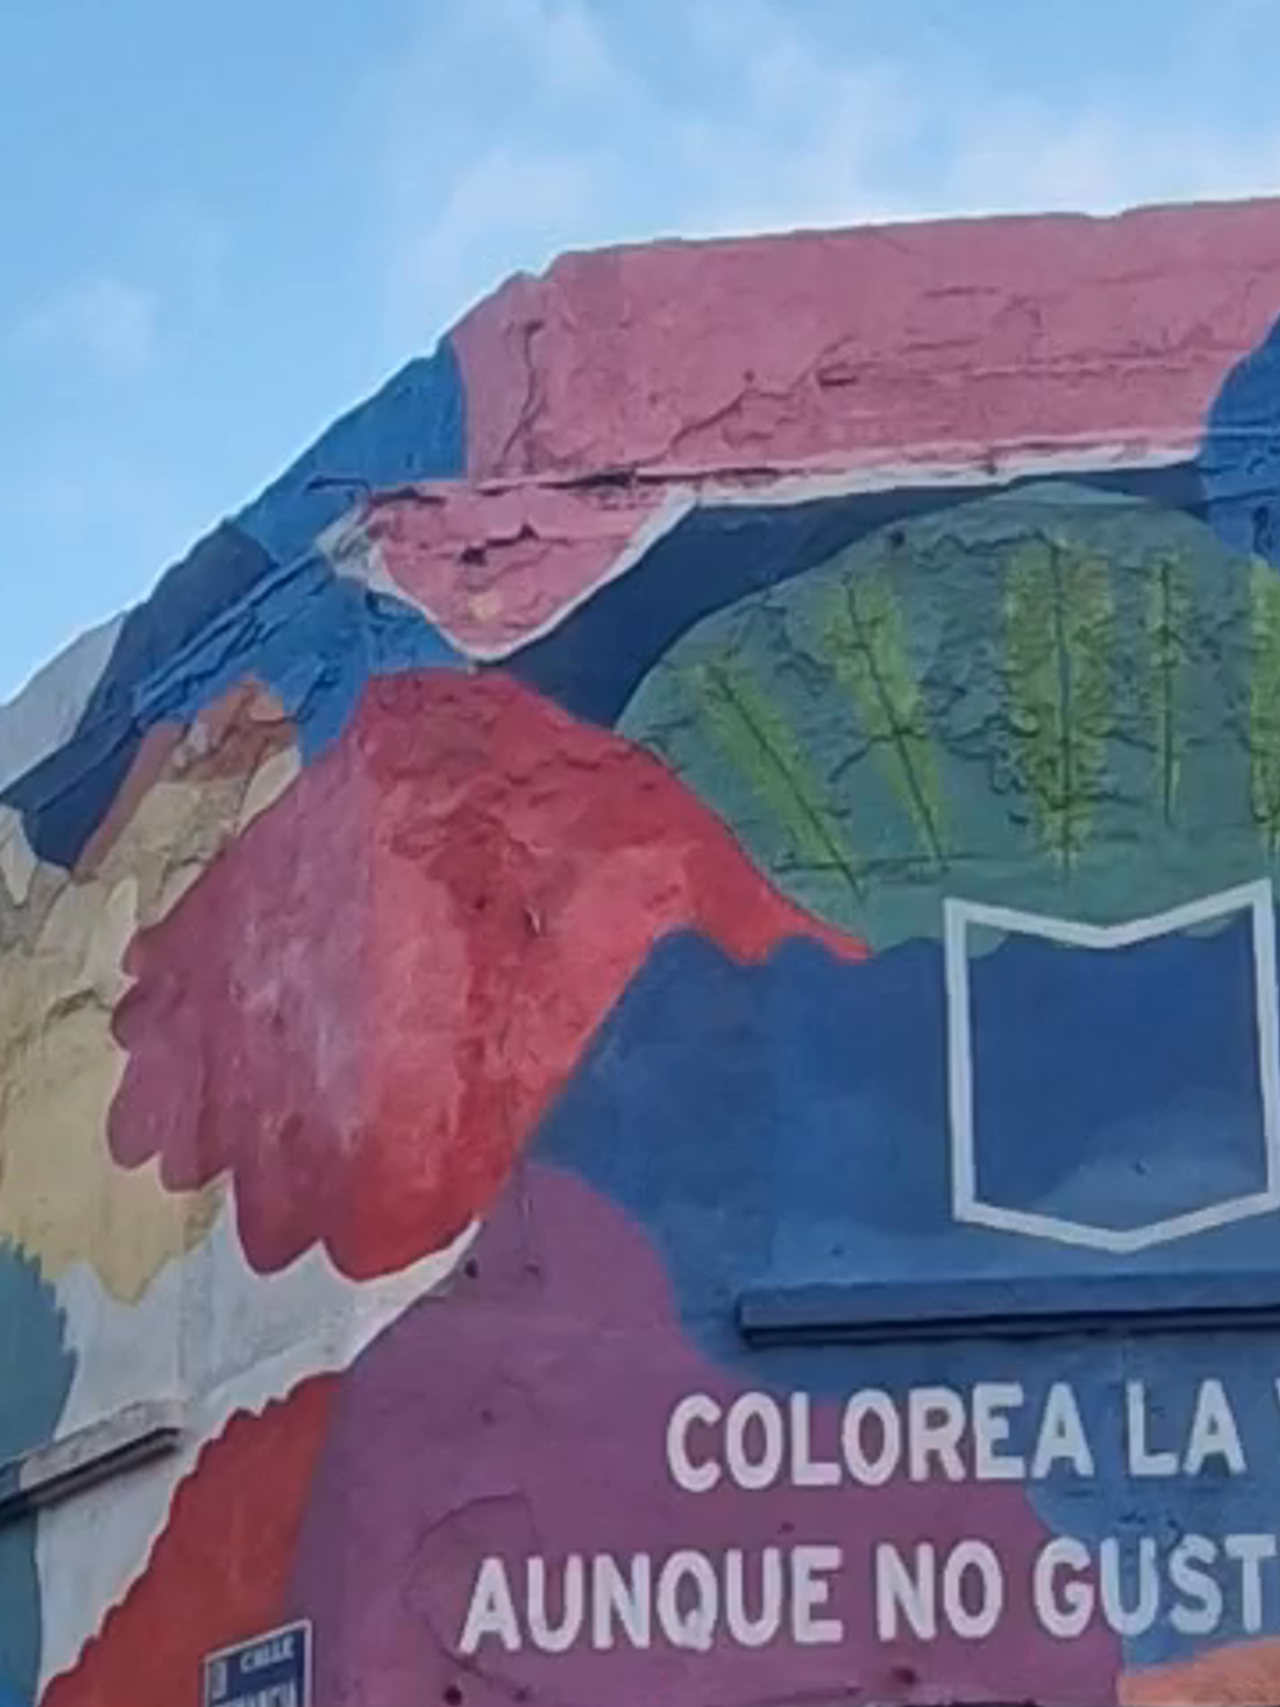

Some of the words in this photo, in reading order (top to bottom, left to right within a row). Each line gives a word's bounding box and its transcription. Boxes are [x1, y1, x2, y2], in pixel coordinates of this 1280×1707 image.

[666, 1381, 1095, 1492] COLOREA
[1125, 1378, 1248, 1477] LA
[240, 1634, 294, 1672] CALLE
[458, 1545, 844, 1654] AUNQUE
[876, 1539, 1004, 1642] NO
